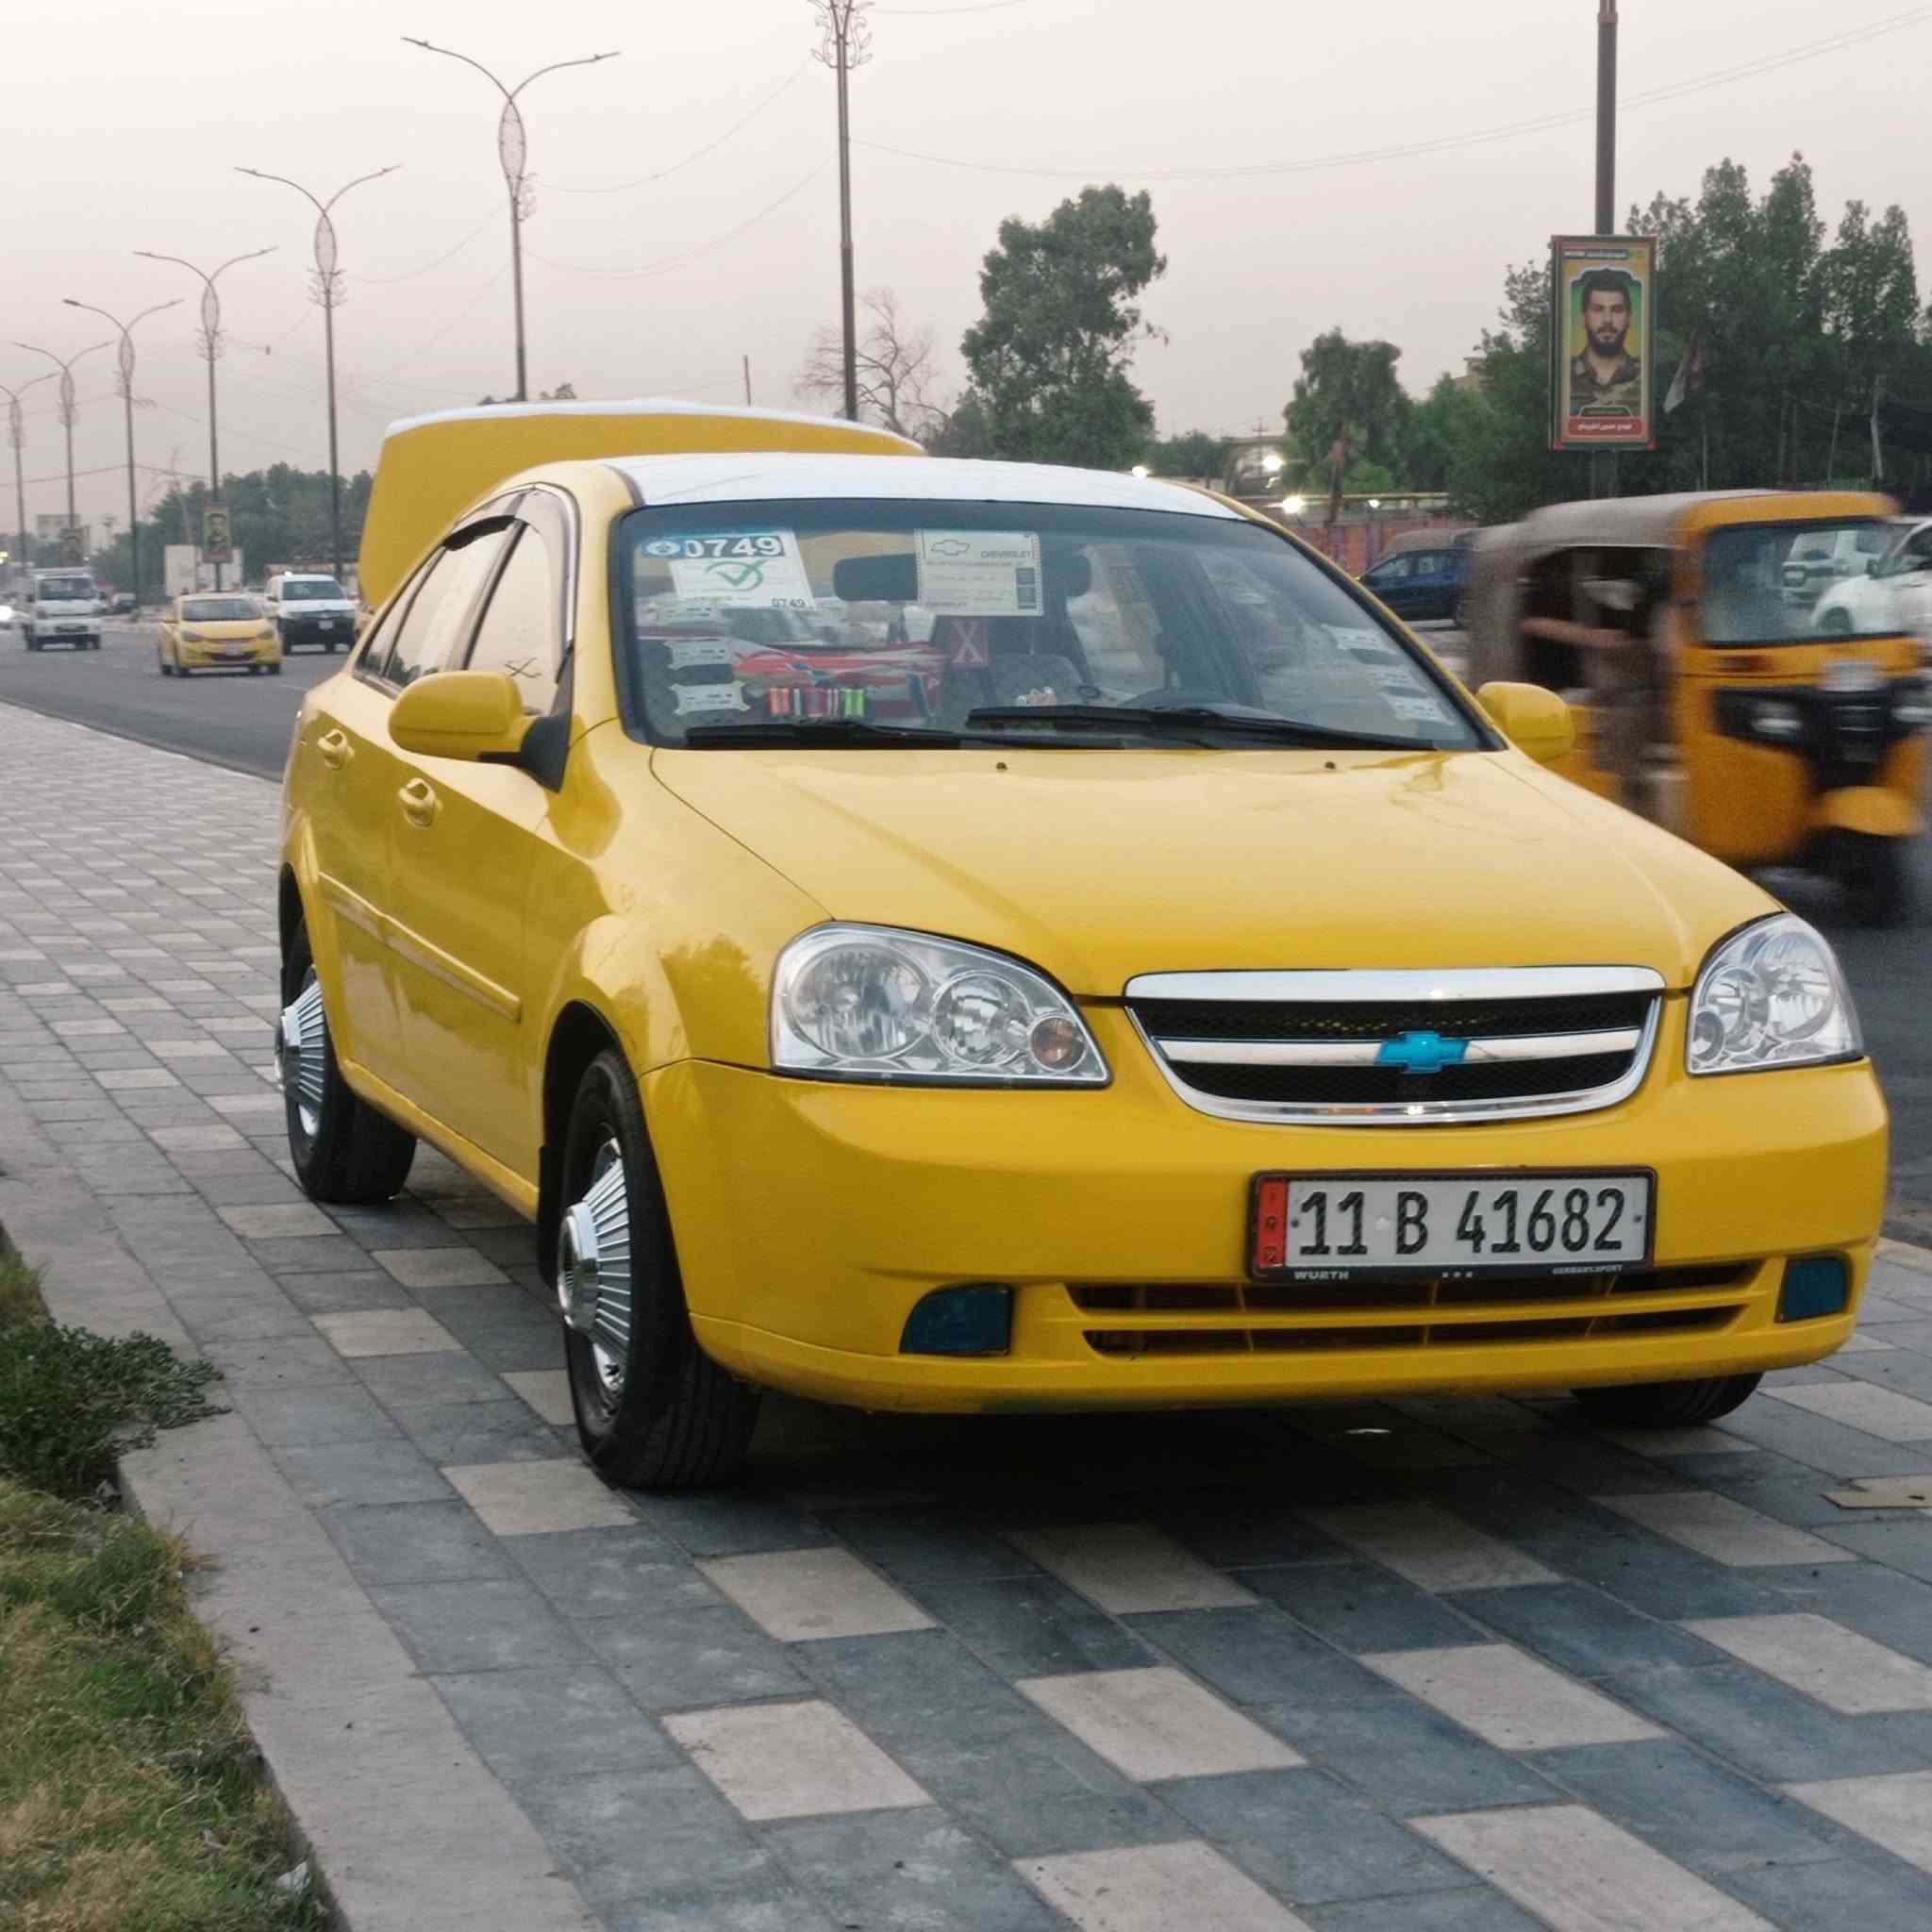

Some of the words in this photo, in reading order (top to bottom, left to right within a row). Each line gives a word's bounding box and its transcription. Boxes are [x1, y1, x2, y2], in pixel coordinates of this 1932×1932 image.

[684, 536, 781, 558] 0749
[771, 597, 807, 608] 0749
[1299, 1191, 1368, 1256] 11
[1395, 1191, 1429, 1255] B
[1456, 1188, 1625, 1254] 41682
